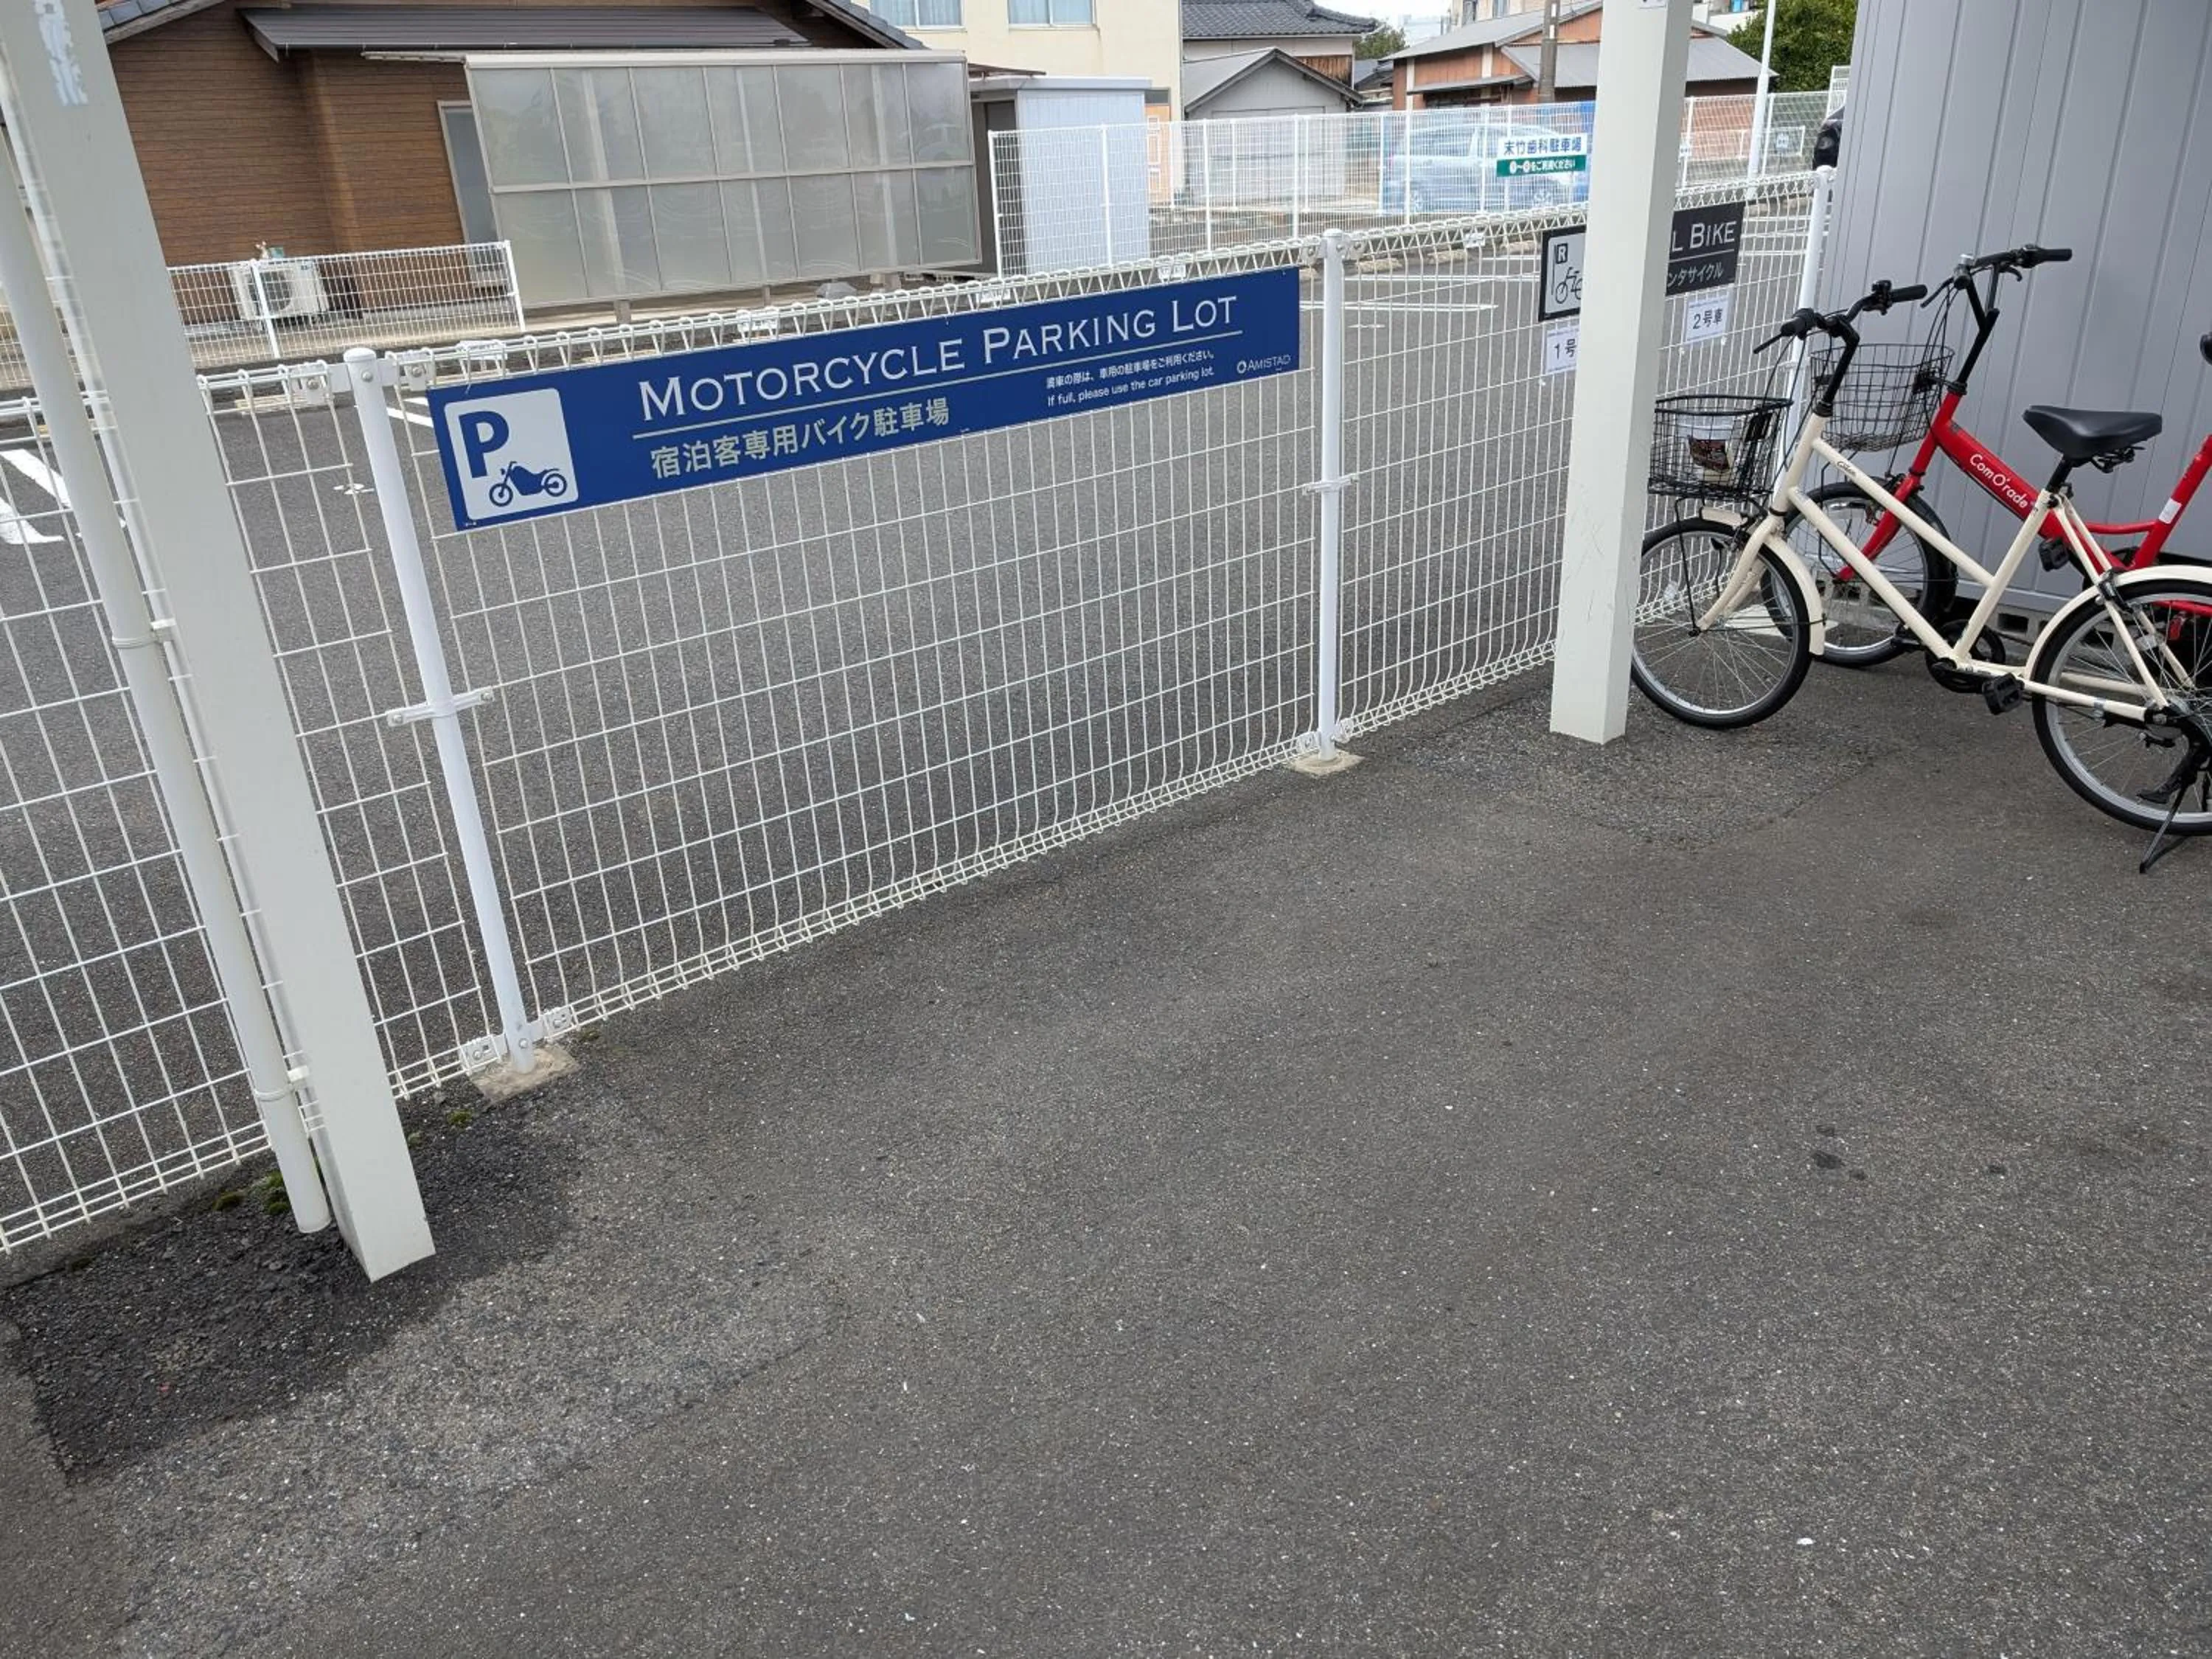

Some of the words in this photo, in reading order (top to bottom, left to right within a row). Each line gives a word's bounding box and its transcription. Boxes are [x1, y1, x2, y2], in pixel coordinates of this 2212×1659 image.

[1689, 220, 1736, 249] BIKE
[1667, 262, 1725, 288] ンタサイクル
[1692, 308, 1723, 330] 2号車
[639, 338, 965, 421] MOTORCYCLE
[983, 309, 1156, 365] PARKING
[1172, 296, 1238, 333] LOT
[1247, 355, 1292, 371] AMISTAD
[1554, 338, 1577, 360] 1号
[1048, 395, 1055, 407] If
[1079, 388, 1110, 403] please
[1111, 383, 1129, 395] use
[1130, 378, 1147, 392] the
[1148, 376, 1164, 388] car
[1166, 369, 1200, 387] parking
[459, 410, 509, 479] P
[651, 397, 950, 479] 宿泊客専用バイク駐車場
